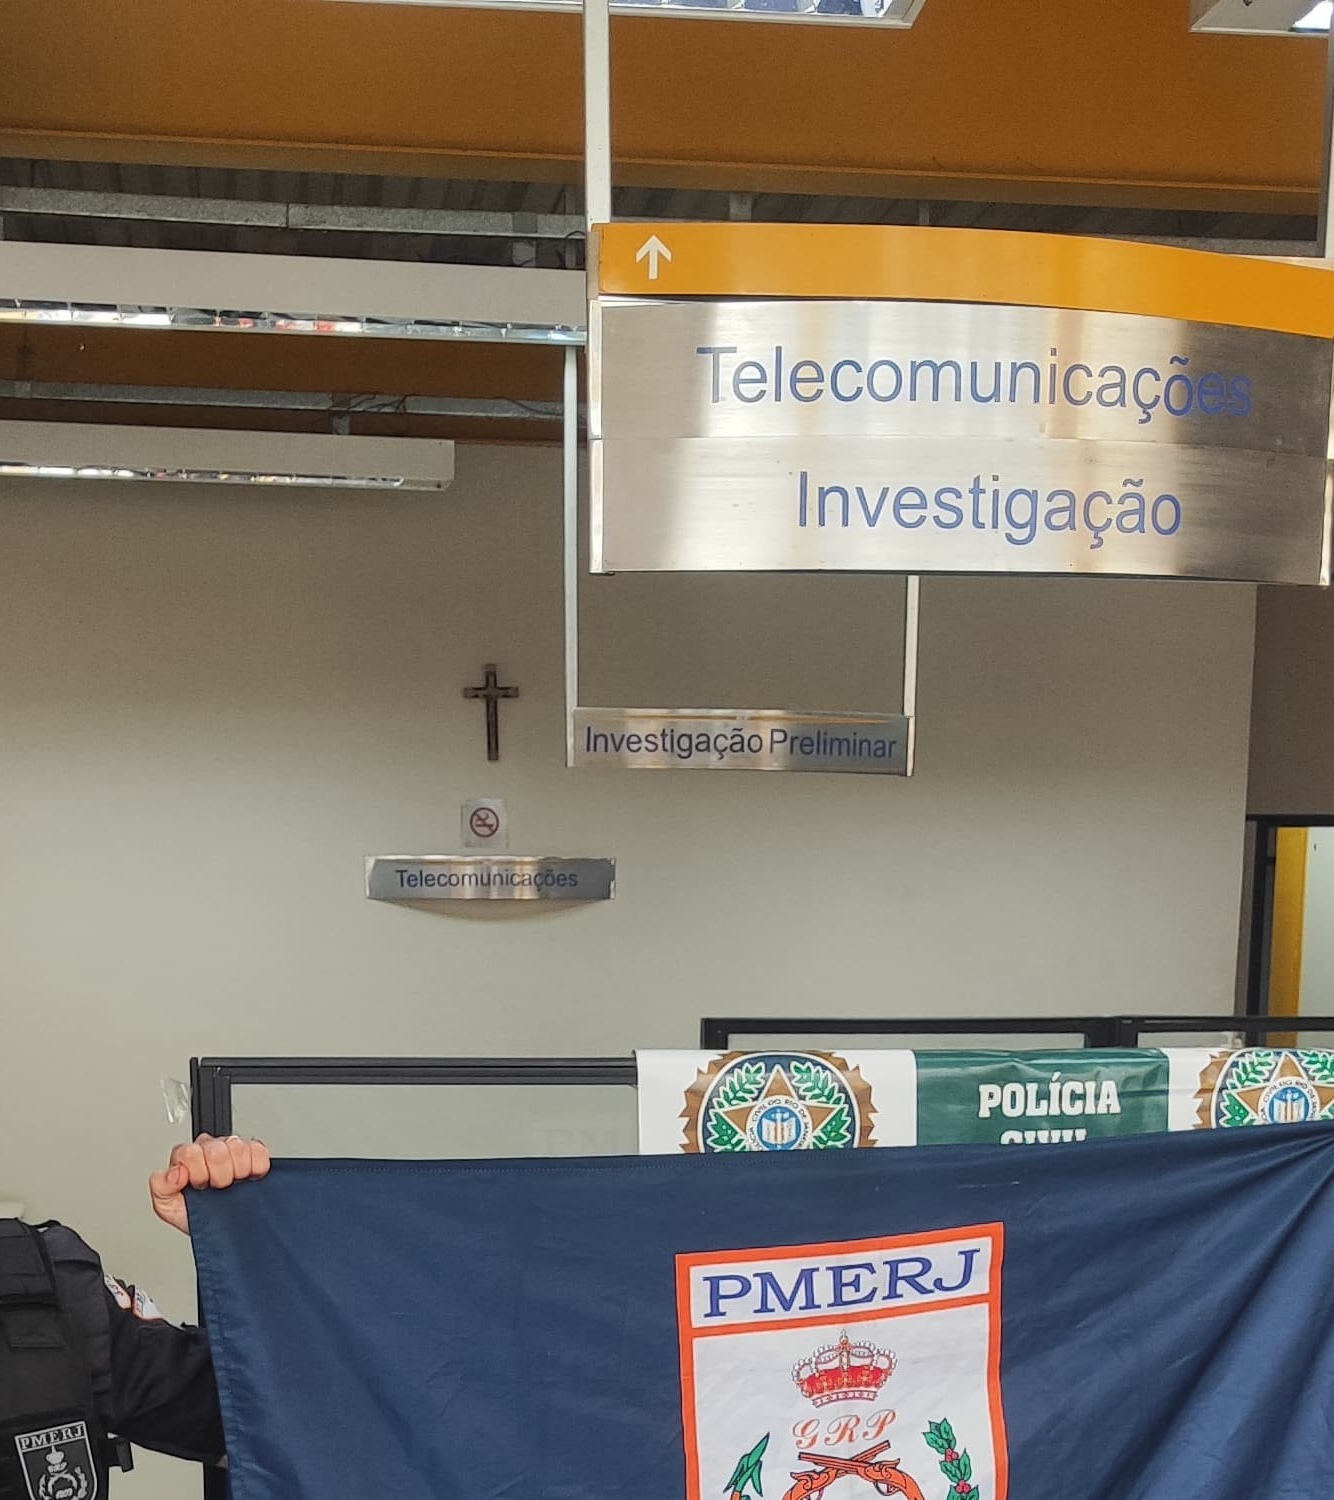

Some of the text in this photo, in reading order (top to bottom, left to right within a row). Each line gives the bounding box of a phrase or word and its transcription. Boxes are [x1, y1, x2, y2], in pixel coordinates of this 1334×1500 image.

[695, 344, 1254, 425] Telecomunicações
[797, 469, 1183, 550] Investigação
[585, 725, 898, 762] Investigação Preliminar
[394, 867, 580, 894] Telecomunicações
[978, 1070, 1122, 1119] POLÍCIA
[701, 1247, 982, 1320] PMERJ
[19, 1424, 83, 1450] PMERJ
